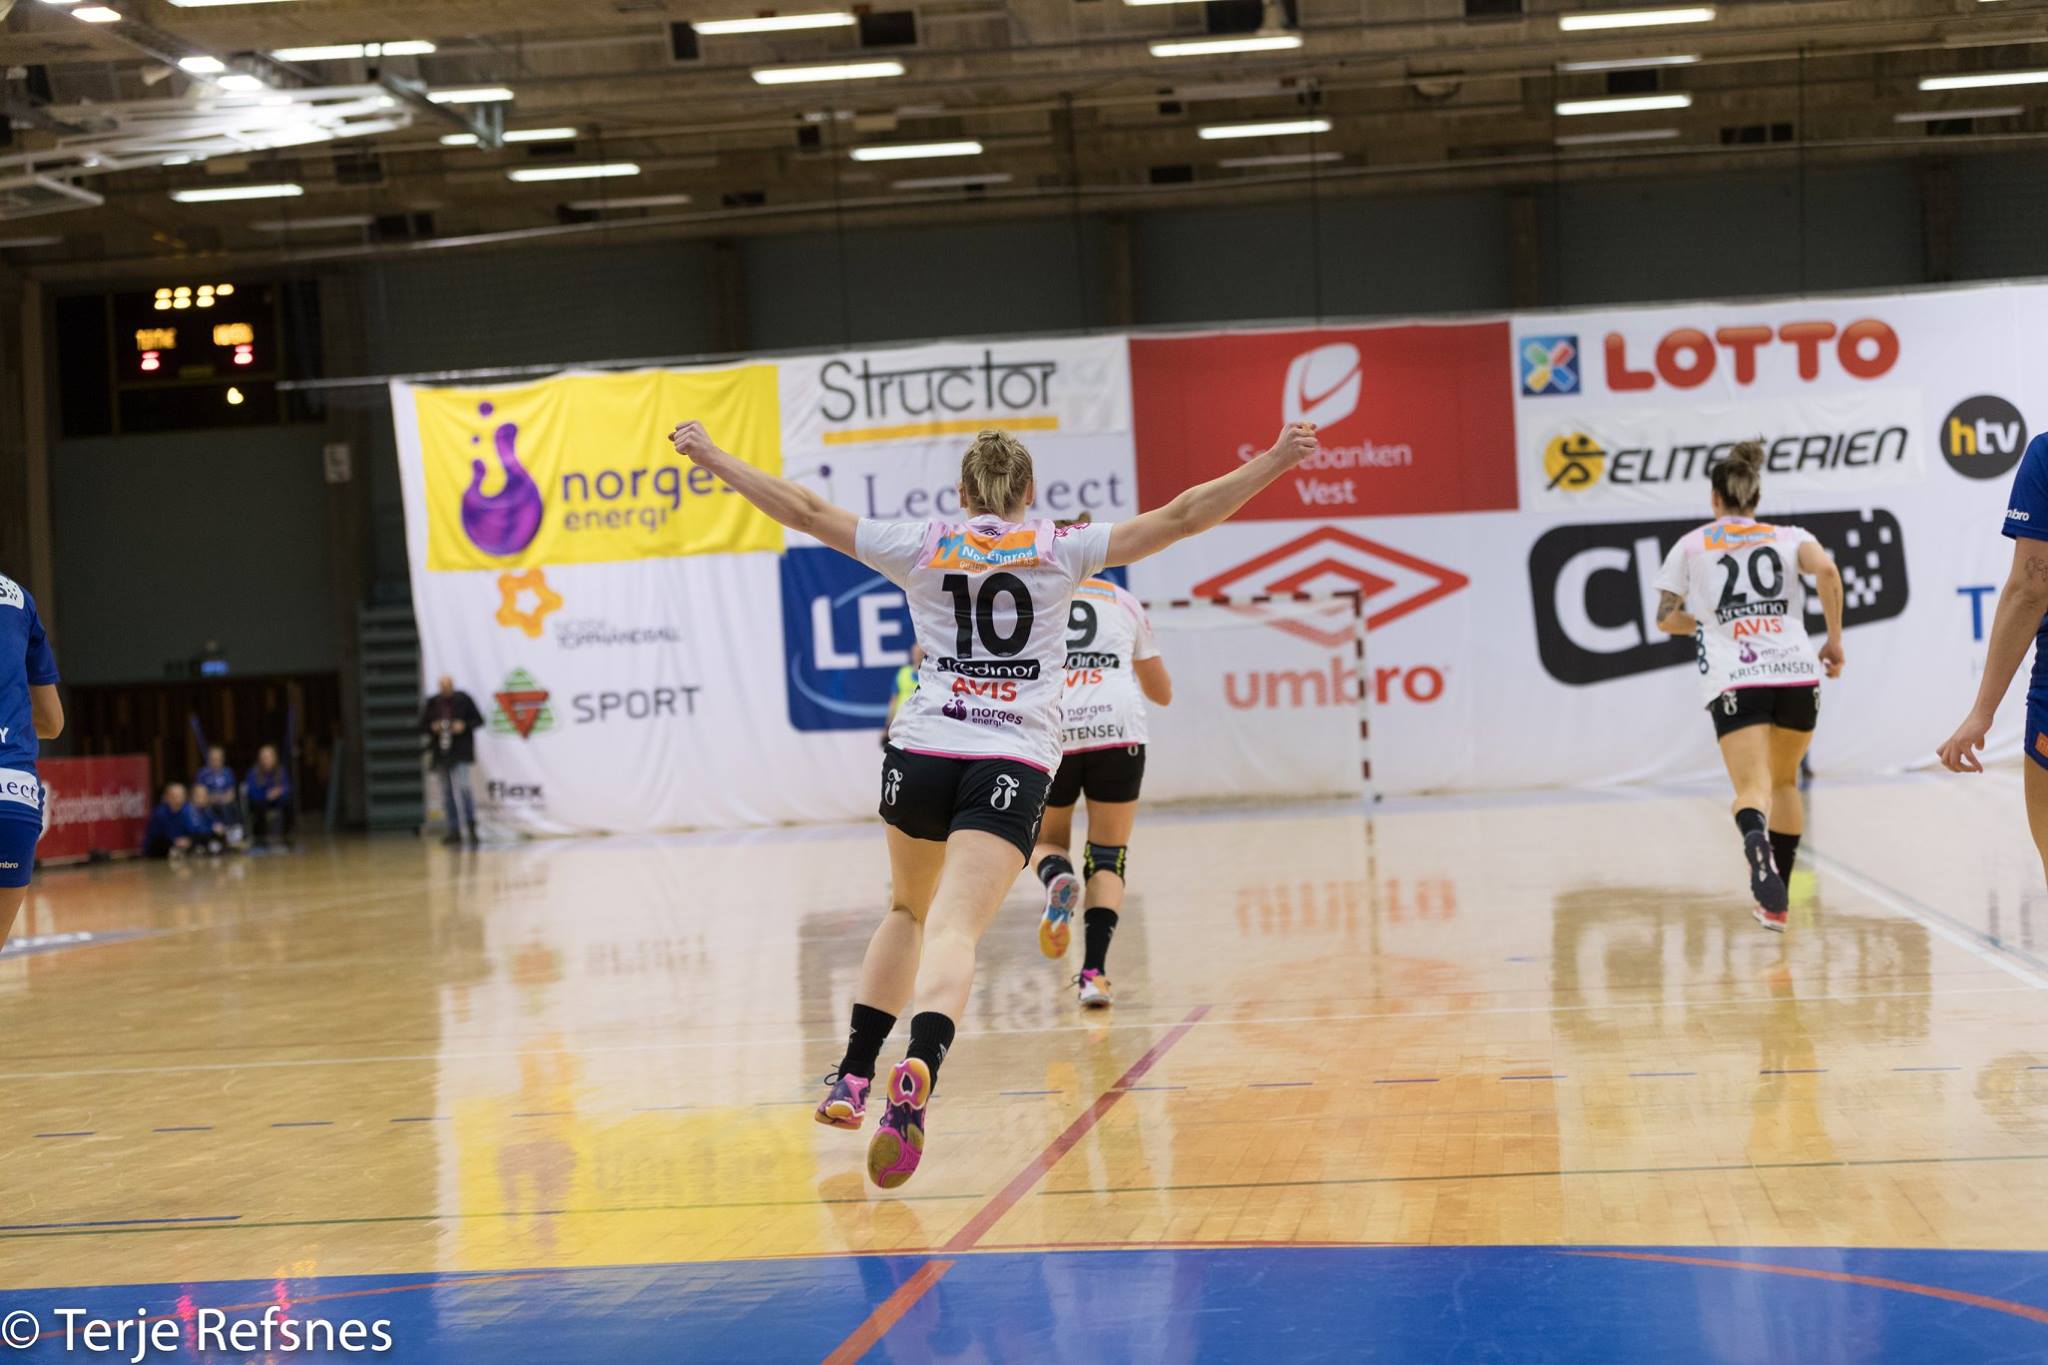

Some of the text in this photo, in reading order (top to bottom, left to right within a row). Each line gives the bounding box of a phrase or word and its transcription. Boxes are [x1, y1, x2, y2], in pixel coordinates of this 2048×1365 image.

[1605, 318, 1900, 392] LOTTO
[820, 349, 1056, 423] Structor
[1949, 416, 2020, 456] htv
[1608, 426, 1908, 484] ELITEERIEN
[1295, 477, 1357, 505] Vest
[564, 503, 672, 533] energi
[1716, 546, 1784, 612] 20
[942, 572, 1035, 659] 10
[1733, 617, 1784, 640] AVIS
[951, 676, 1018, 703] AVIS
[1065, 669, 1104, 688] VIS
[1224, 656, 1444, 710] umbro
[1729, 663, 1815, 682] KRISTIANSEN
[572, 686, 700, 724] SPORT
[971, 706, 1024, 725] norges
[1067, 703, 1113, 719] norges
